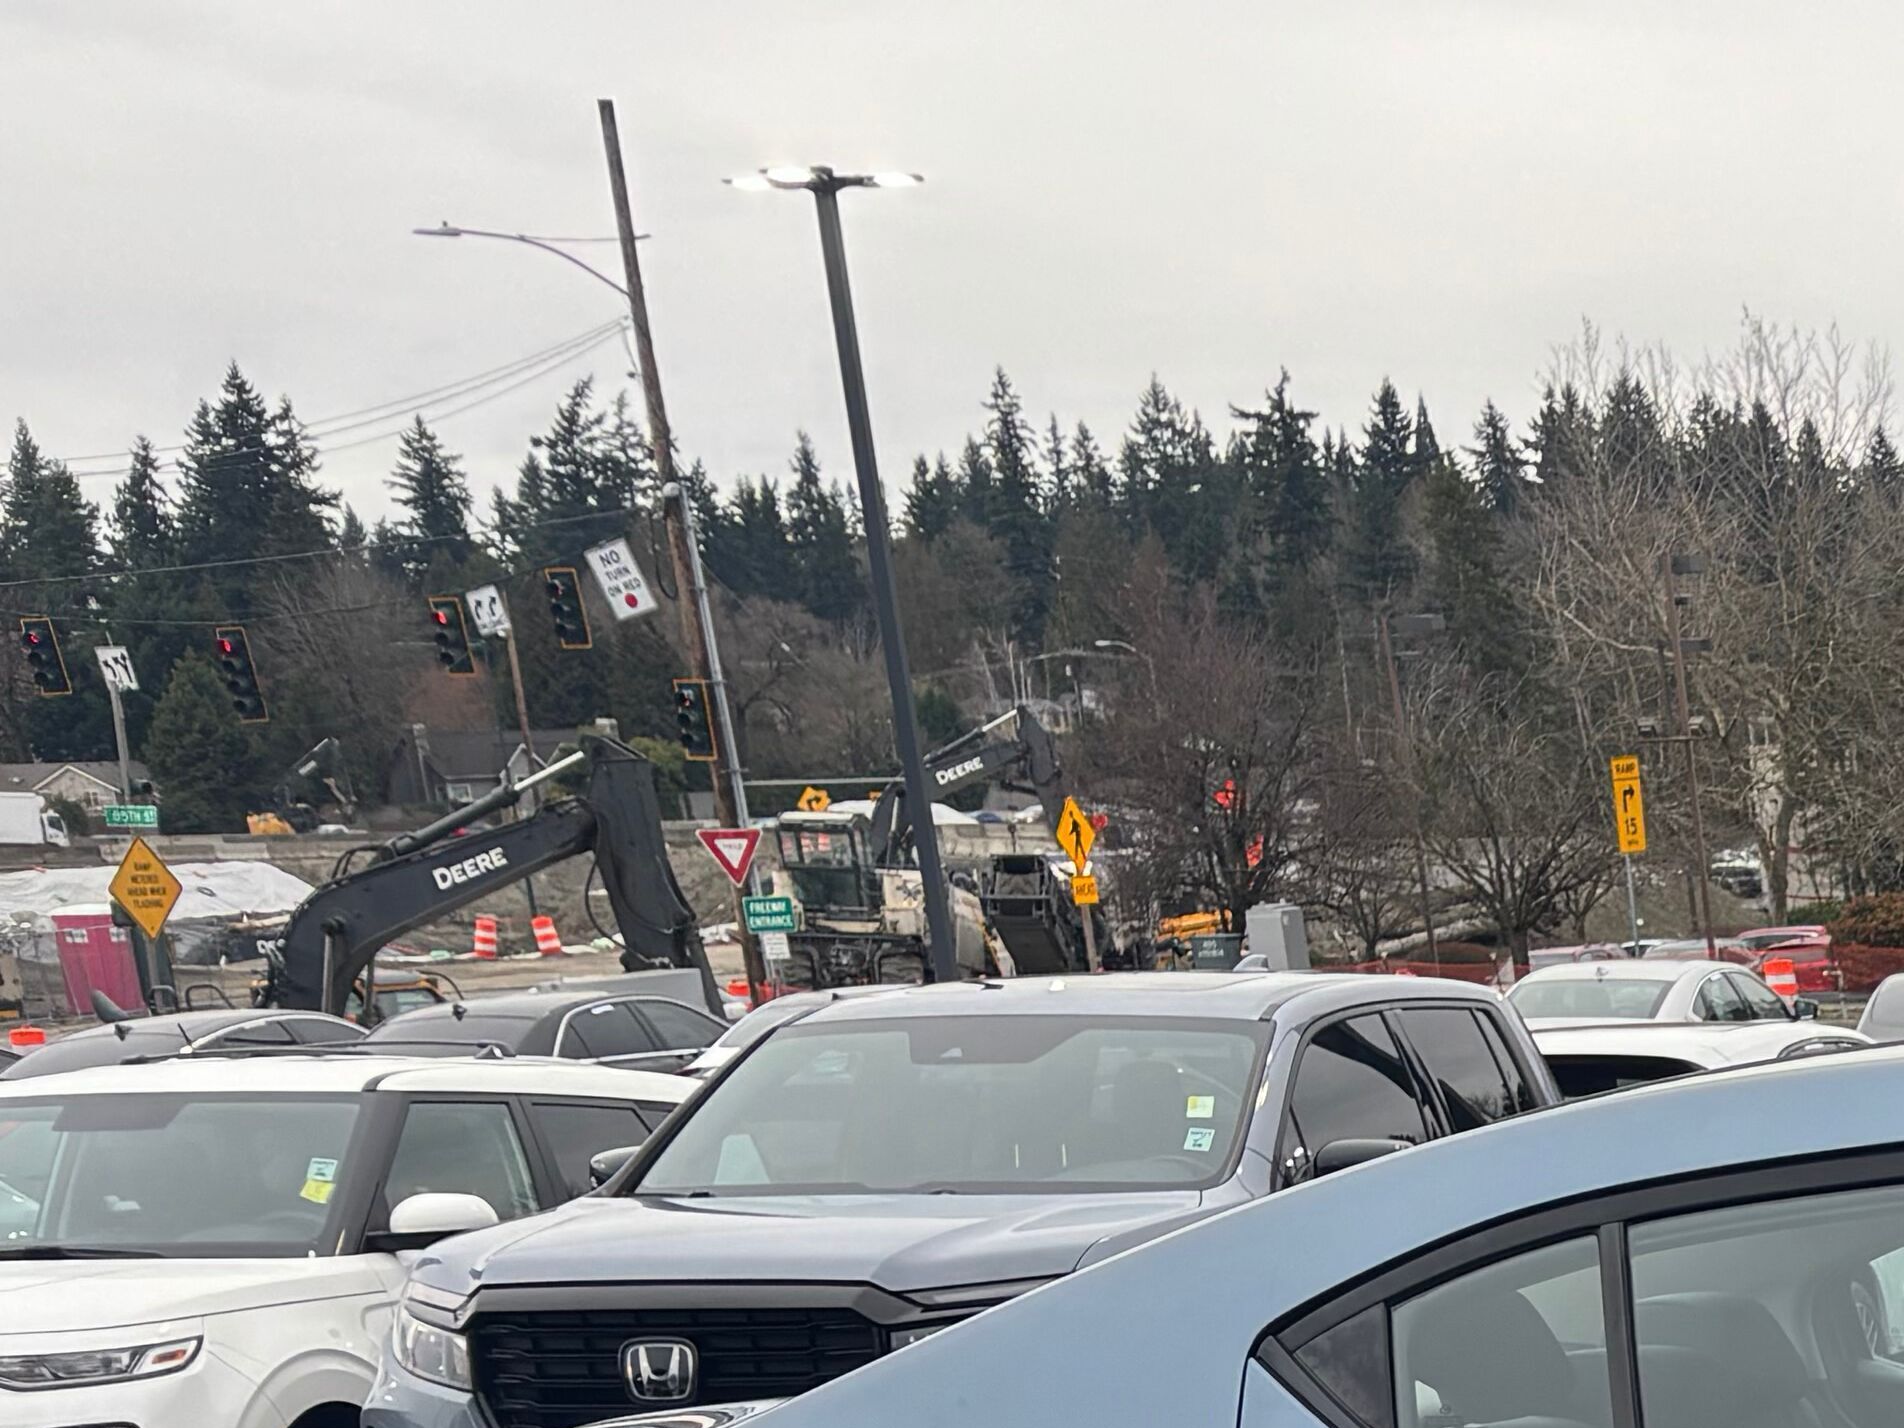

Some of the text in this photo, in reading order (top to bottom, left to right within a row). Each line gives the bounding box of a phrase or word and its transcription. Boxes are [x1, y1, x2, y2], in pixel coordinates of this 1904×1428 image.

[599, 549, 621, 568] NO
[605, 565, 631, 581] TURN
[607, 583, 623, 598] ON
[935, 756, 984, 785] DEERE
[1625, 817, 1638, 836] 15
[432, 846, 509, 891] DEERE
